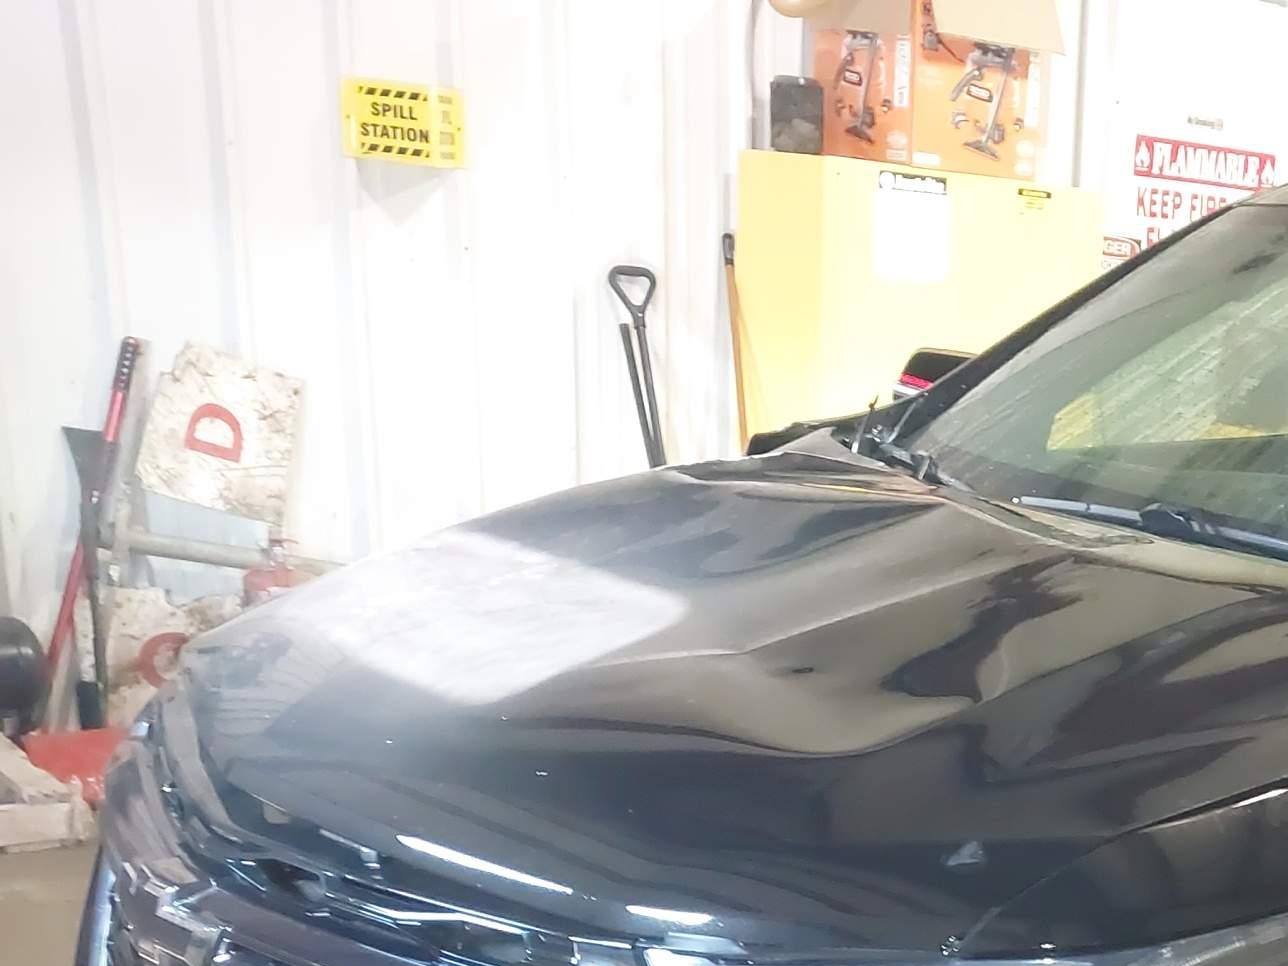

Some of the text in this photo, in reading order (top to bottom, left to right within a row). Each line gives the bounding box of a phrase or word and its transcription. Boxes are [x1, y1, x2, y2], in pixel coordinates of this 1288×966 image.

[370, 102, 418, 120] SPILL
[360, 122, 430, 143] STATION
[1150, 140, 1261, 187] FLAMMABLE
[1136, 186, 1183, 219] KEEP
[184, 402, 243, 464] D
